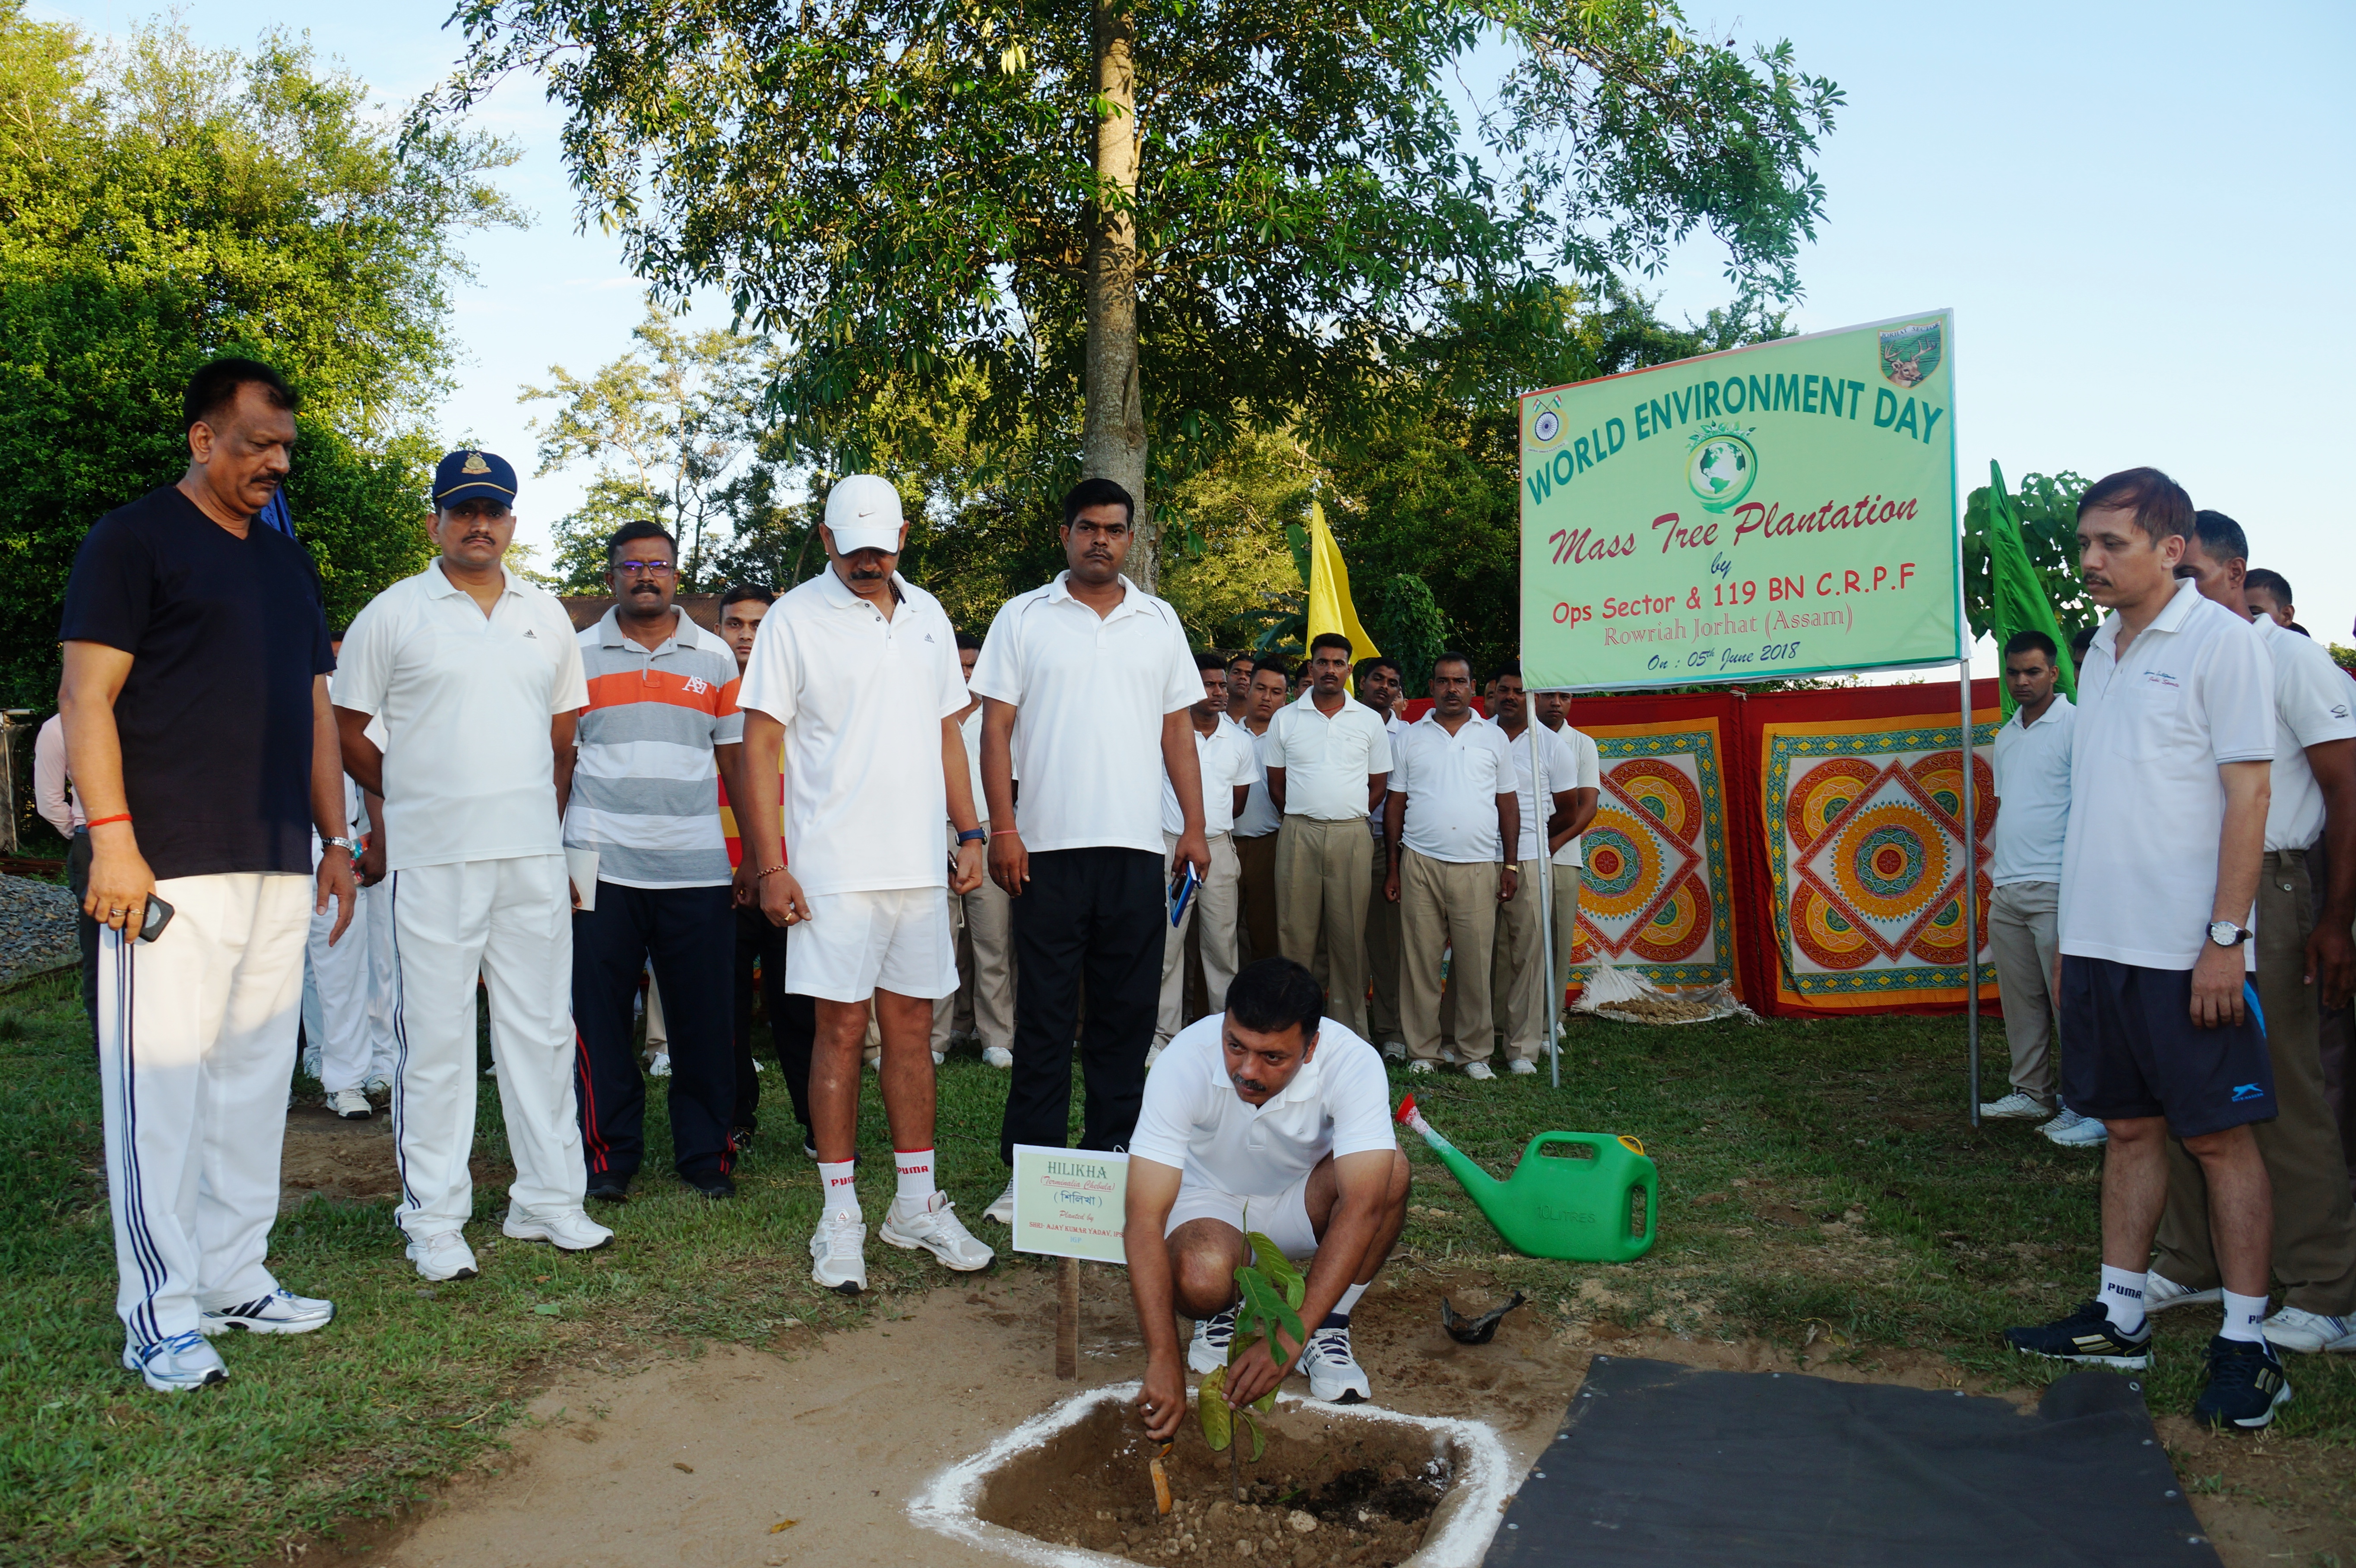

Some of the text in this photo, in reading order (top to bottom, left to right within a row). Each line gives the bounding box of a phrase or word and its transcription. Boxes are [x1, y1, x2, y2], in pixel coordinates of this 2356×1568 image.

[1911, 322, 1939, 332] SECTOR
[1526, 373, 1944, 506] WORLD ENVIRONMENT DAY
[1549, 494, 1918, 564] Mass Tree Plantation
[1711, 551, 1732, 579] by
[1553, 563, 1916, 629] Ops Sector & 119 BN C.R.P.F
[1604, 601, 1853, 646] Rowriah Jorhat (Assam)
[1647, 654, 1668, 670] On
[1719, 648, 1754, 671] June
[1760, 641, 1801, 661] 2018
[897, 1166, 928, 1174] PUMA
[1048, 1161, 1108, 1179] HILIKHA
[1059, 1210, 1094, 1223] Planted by
[1064, 1226, 1087, 1234] KUMAR
[2107, 1282, 2142, 1300] PUMA
